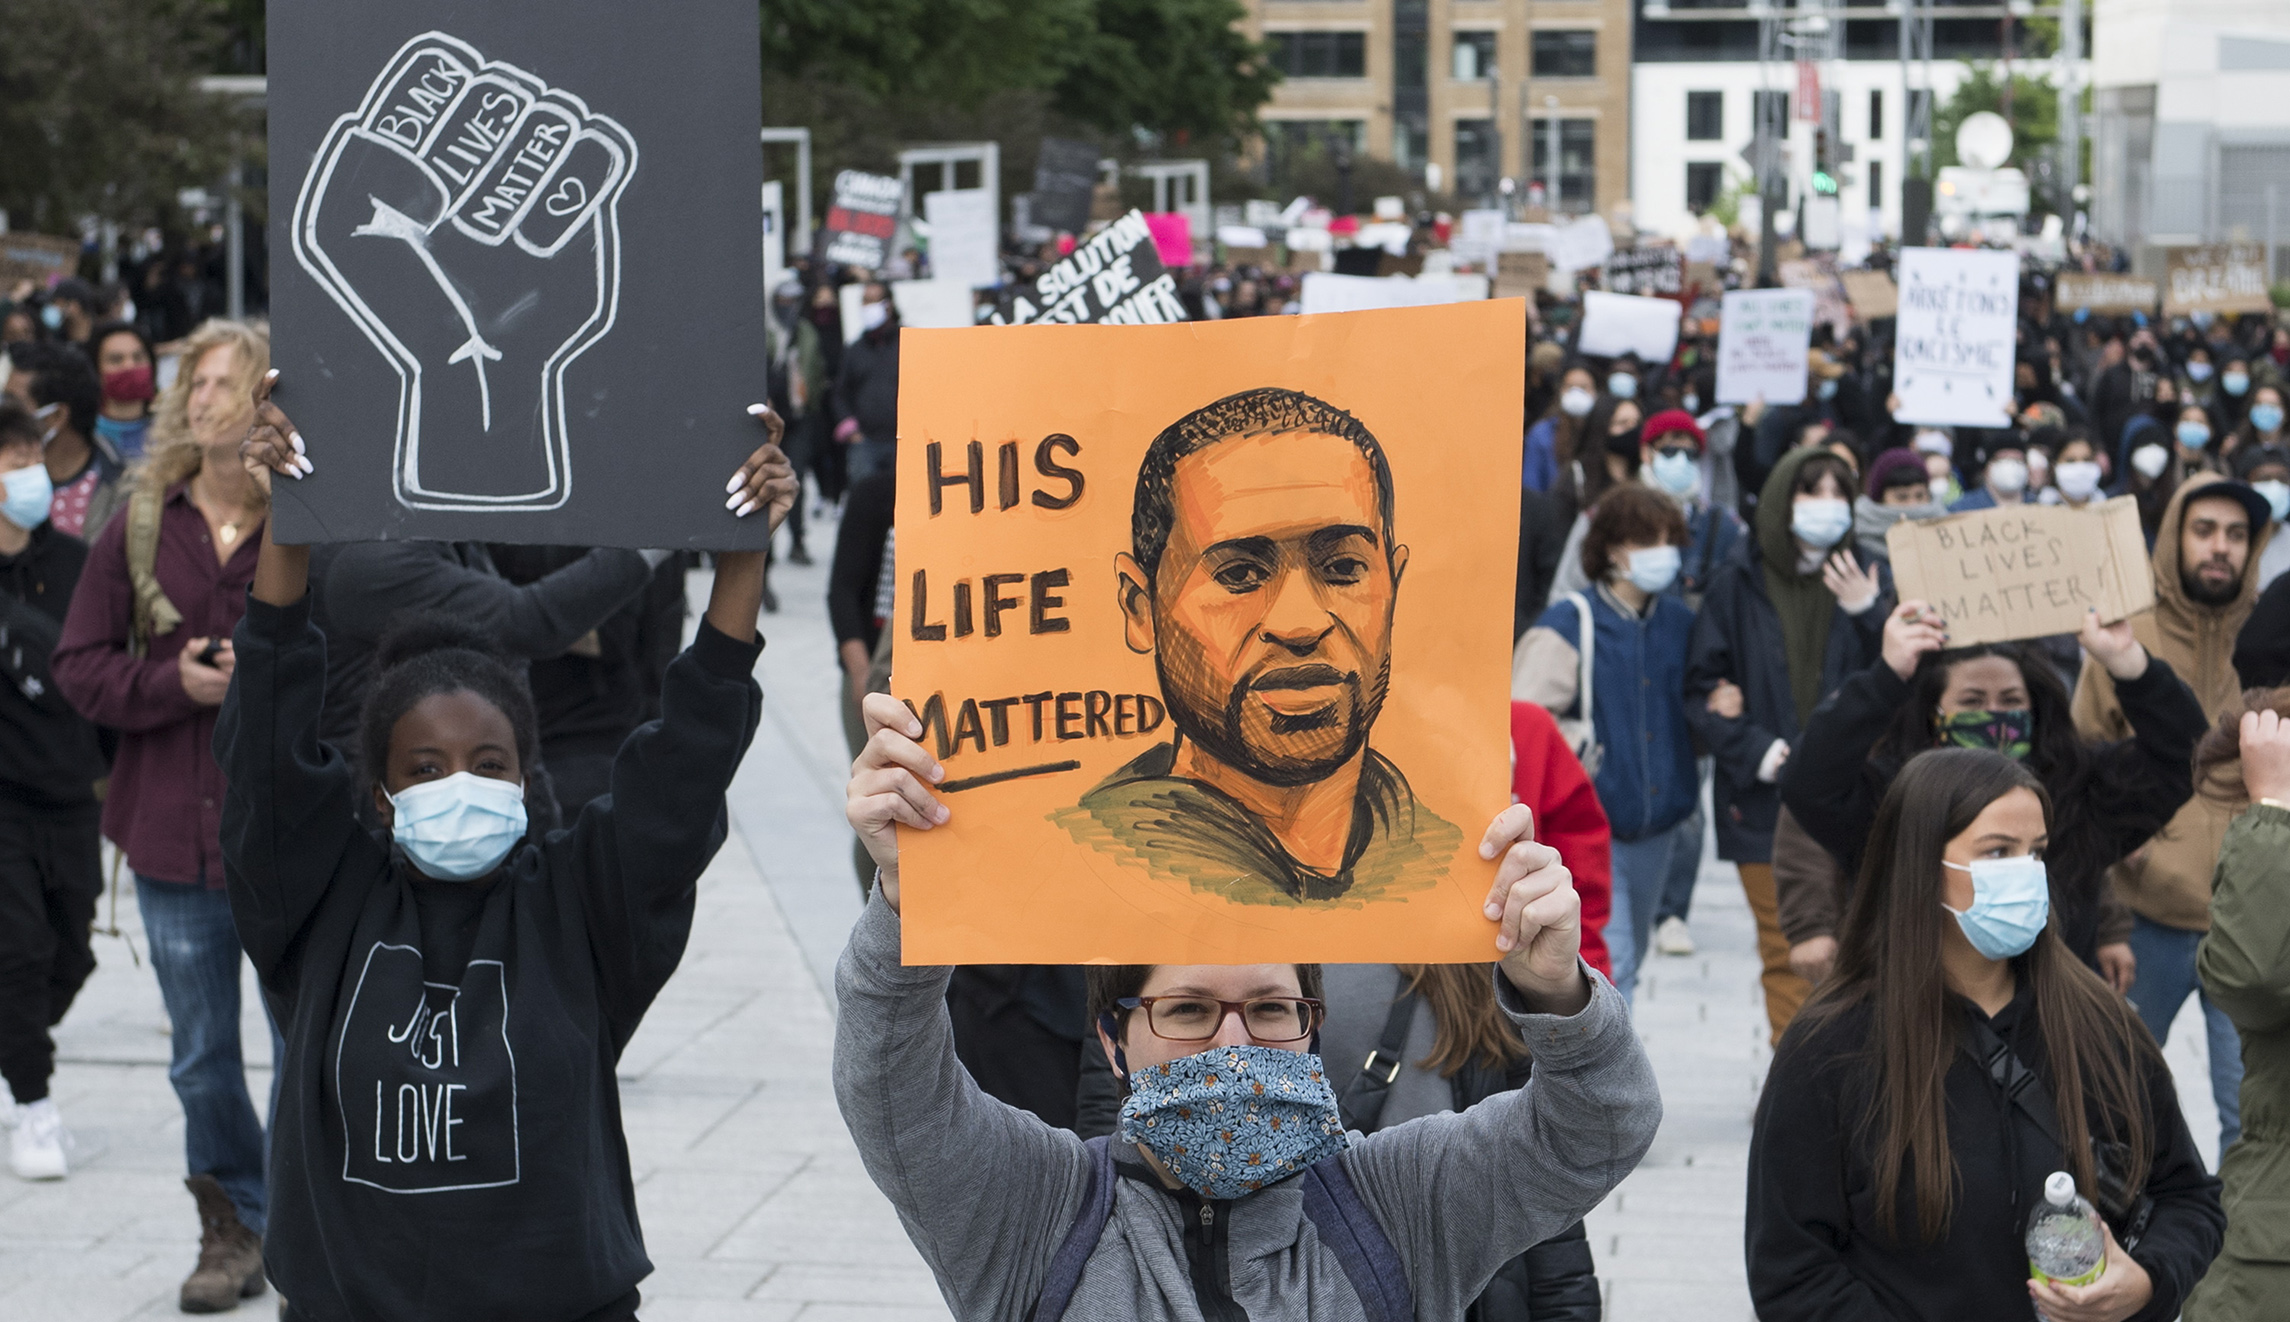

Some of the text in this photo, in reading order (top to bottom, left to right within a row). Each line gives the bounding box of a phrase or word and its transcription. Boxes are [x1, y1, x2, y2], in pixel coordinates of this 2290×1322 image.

[377, 59, 464, 148] BLACK
[433, 91, 519, 186] LIVES
[472, 122, 568, 230] MATTER
[1037, 208, 1149, 305] SOLUTION
[1092, 254, 1140, 308] DE
[926, 433, 1085, 518] HIS
[1935, 517, 2046, 550] BLACK
[1960, 537, 2063, 580] LIVES
[911, 567, 1071, 642] LIFE
[903, 690, 1166, 760] MATTERED
[375, 1080, 467, 1163] LOVE
